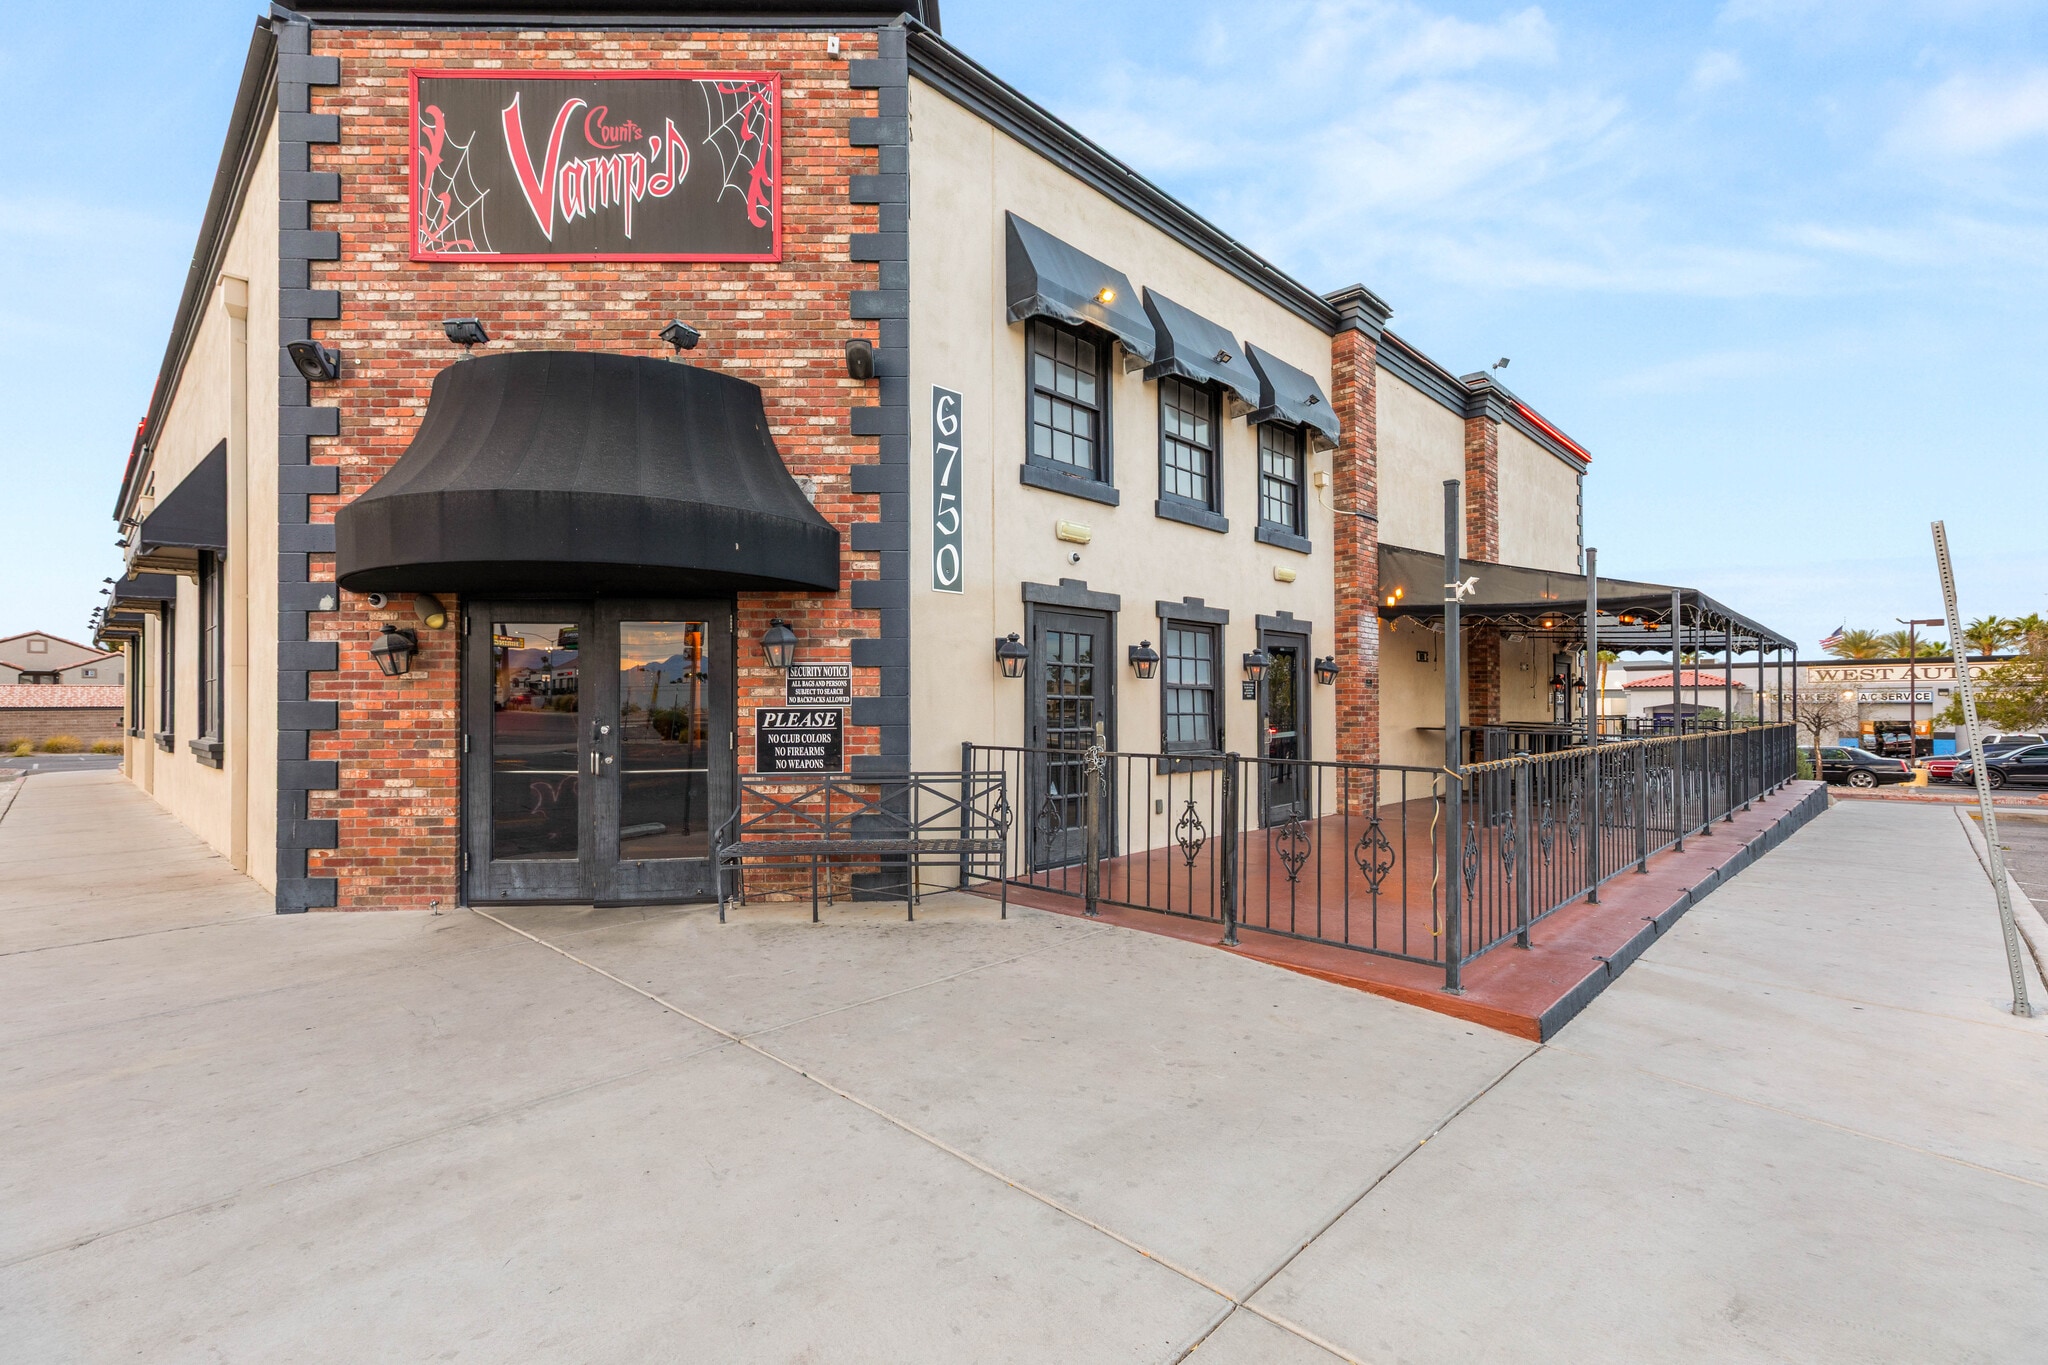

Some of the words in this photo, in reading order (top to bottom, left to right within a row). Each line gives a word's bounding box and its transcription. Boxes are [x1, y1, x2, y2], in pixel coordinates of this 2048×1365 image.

[584, 105, 643, 150] Count's
[935, 395, 960, 586] 6750
[790, 666, 823, 677] SECURITY
[823, 666, 848, 677] NOTICE
[1816, 668, 1894, 681] WEST
[1880, 692, 1930, 701] SERVCE
[762, 712, 837, 728] PLEASE
[768, 734, 780, 744] NO
[780, 734, 800, 744] CLUB
[801, 733, 832, 743] COLORS
[775, 747, 786, 757] NO
[787, 746, 825, 756] FIREARMS
[776, 759, 787, 769] NO
[788, 759, 824, 769] WEAPONS
